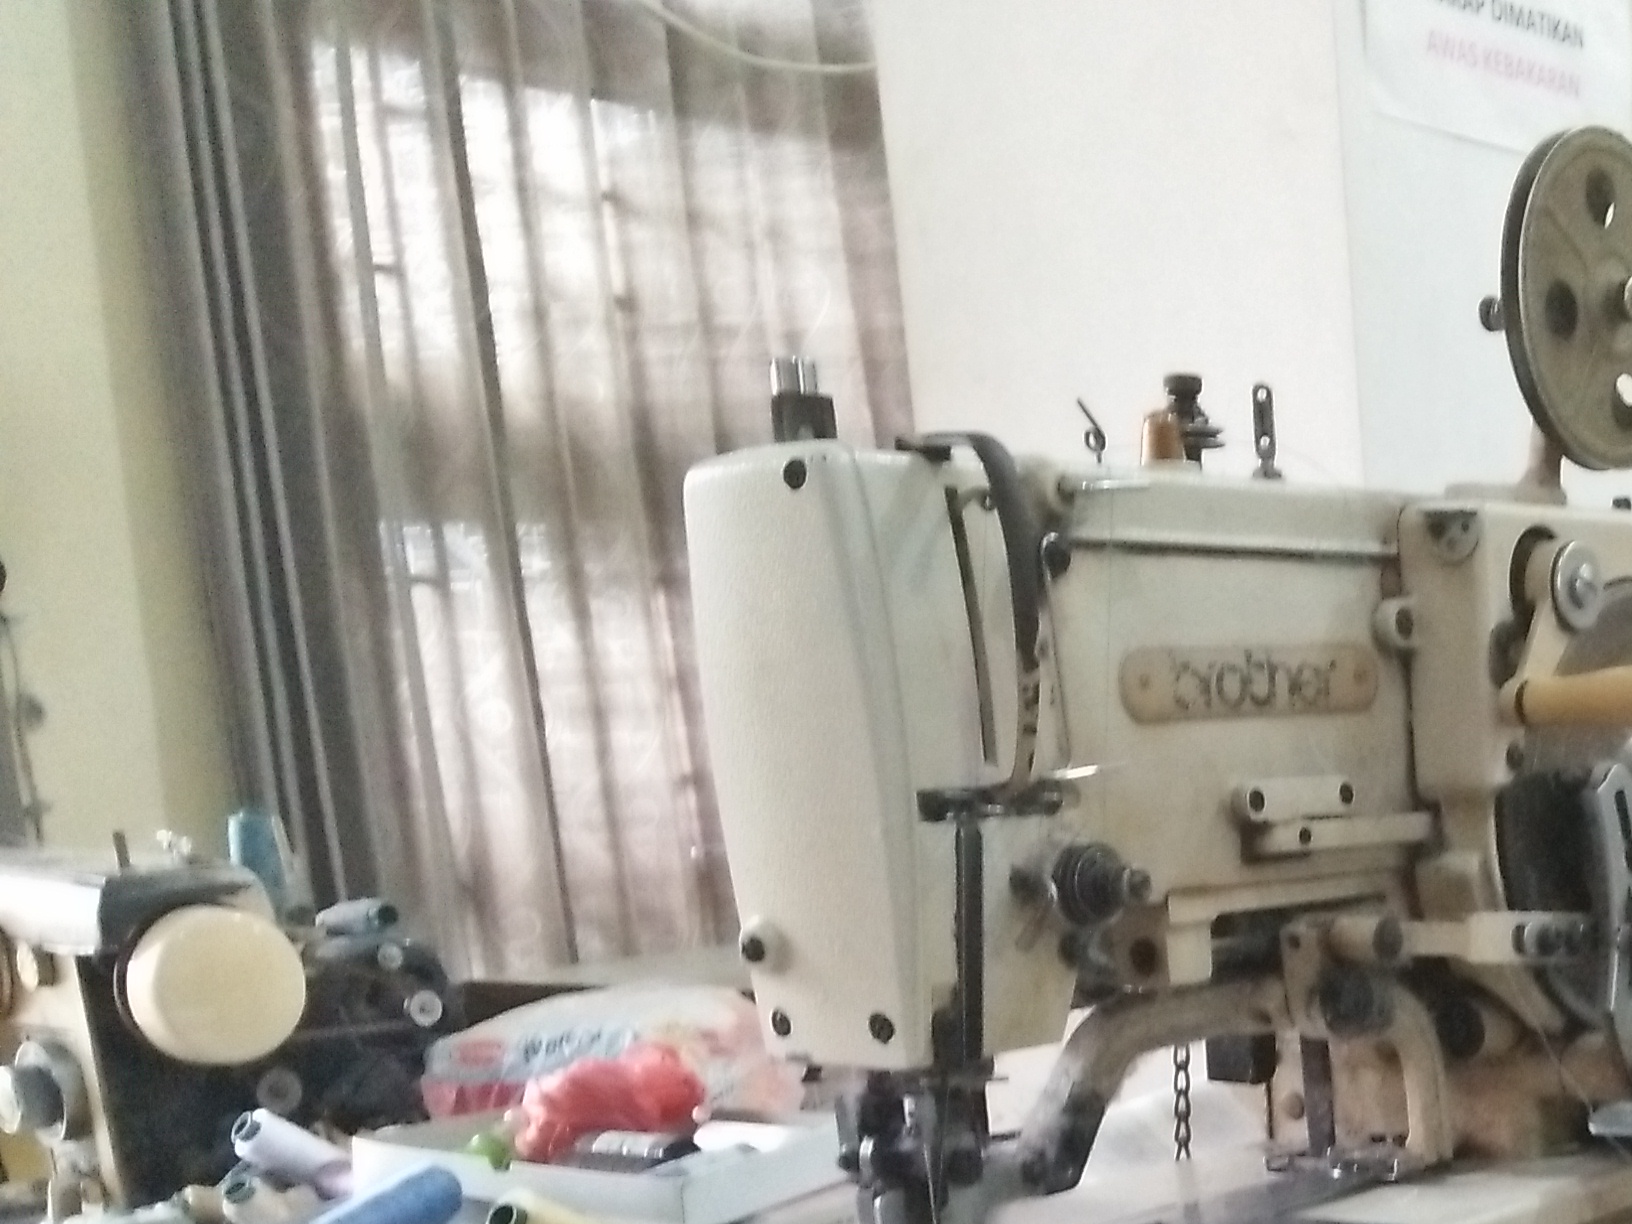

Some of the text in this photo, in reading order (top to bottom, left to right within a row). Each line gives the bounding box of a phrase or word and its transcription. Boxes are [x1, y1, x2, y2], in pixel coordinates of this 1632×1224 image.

[1490, 0, 1584, 48] DIMATIKAN
[1427, 29, 1581, 98] AWAS KEBAKARAN
